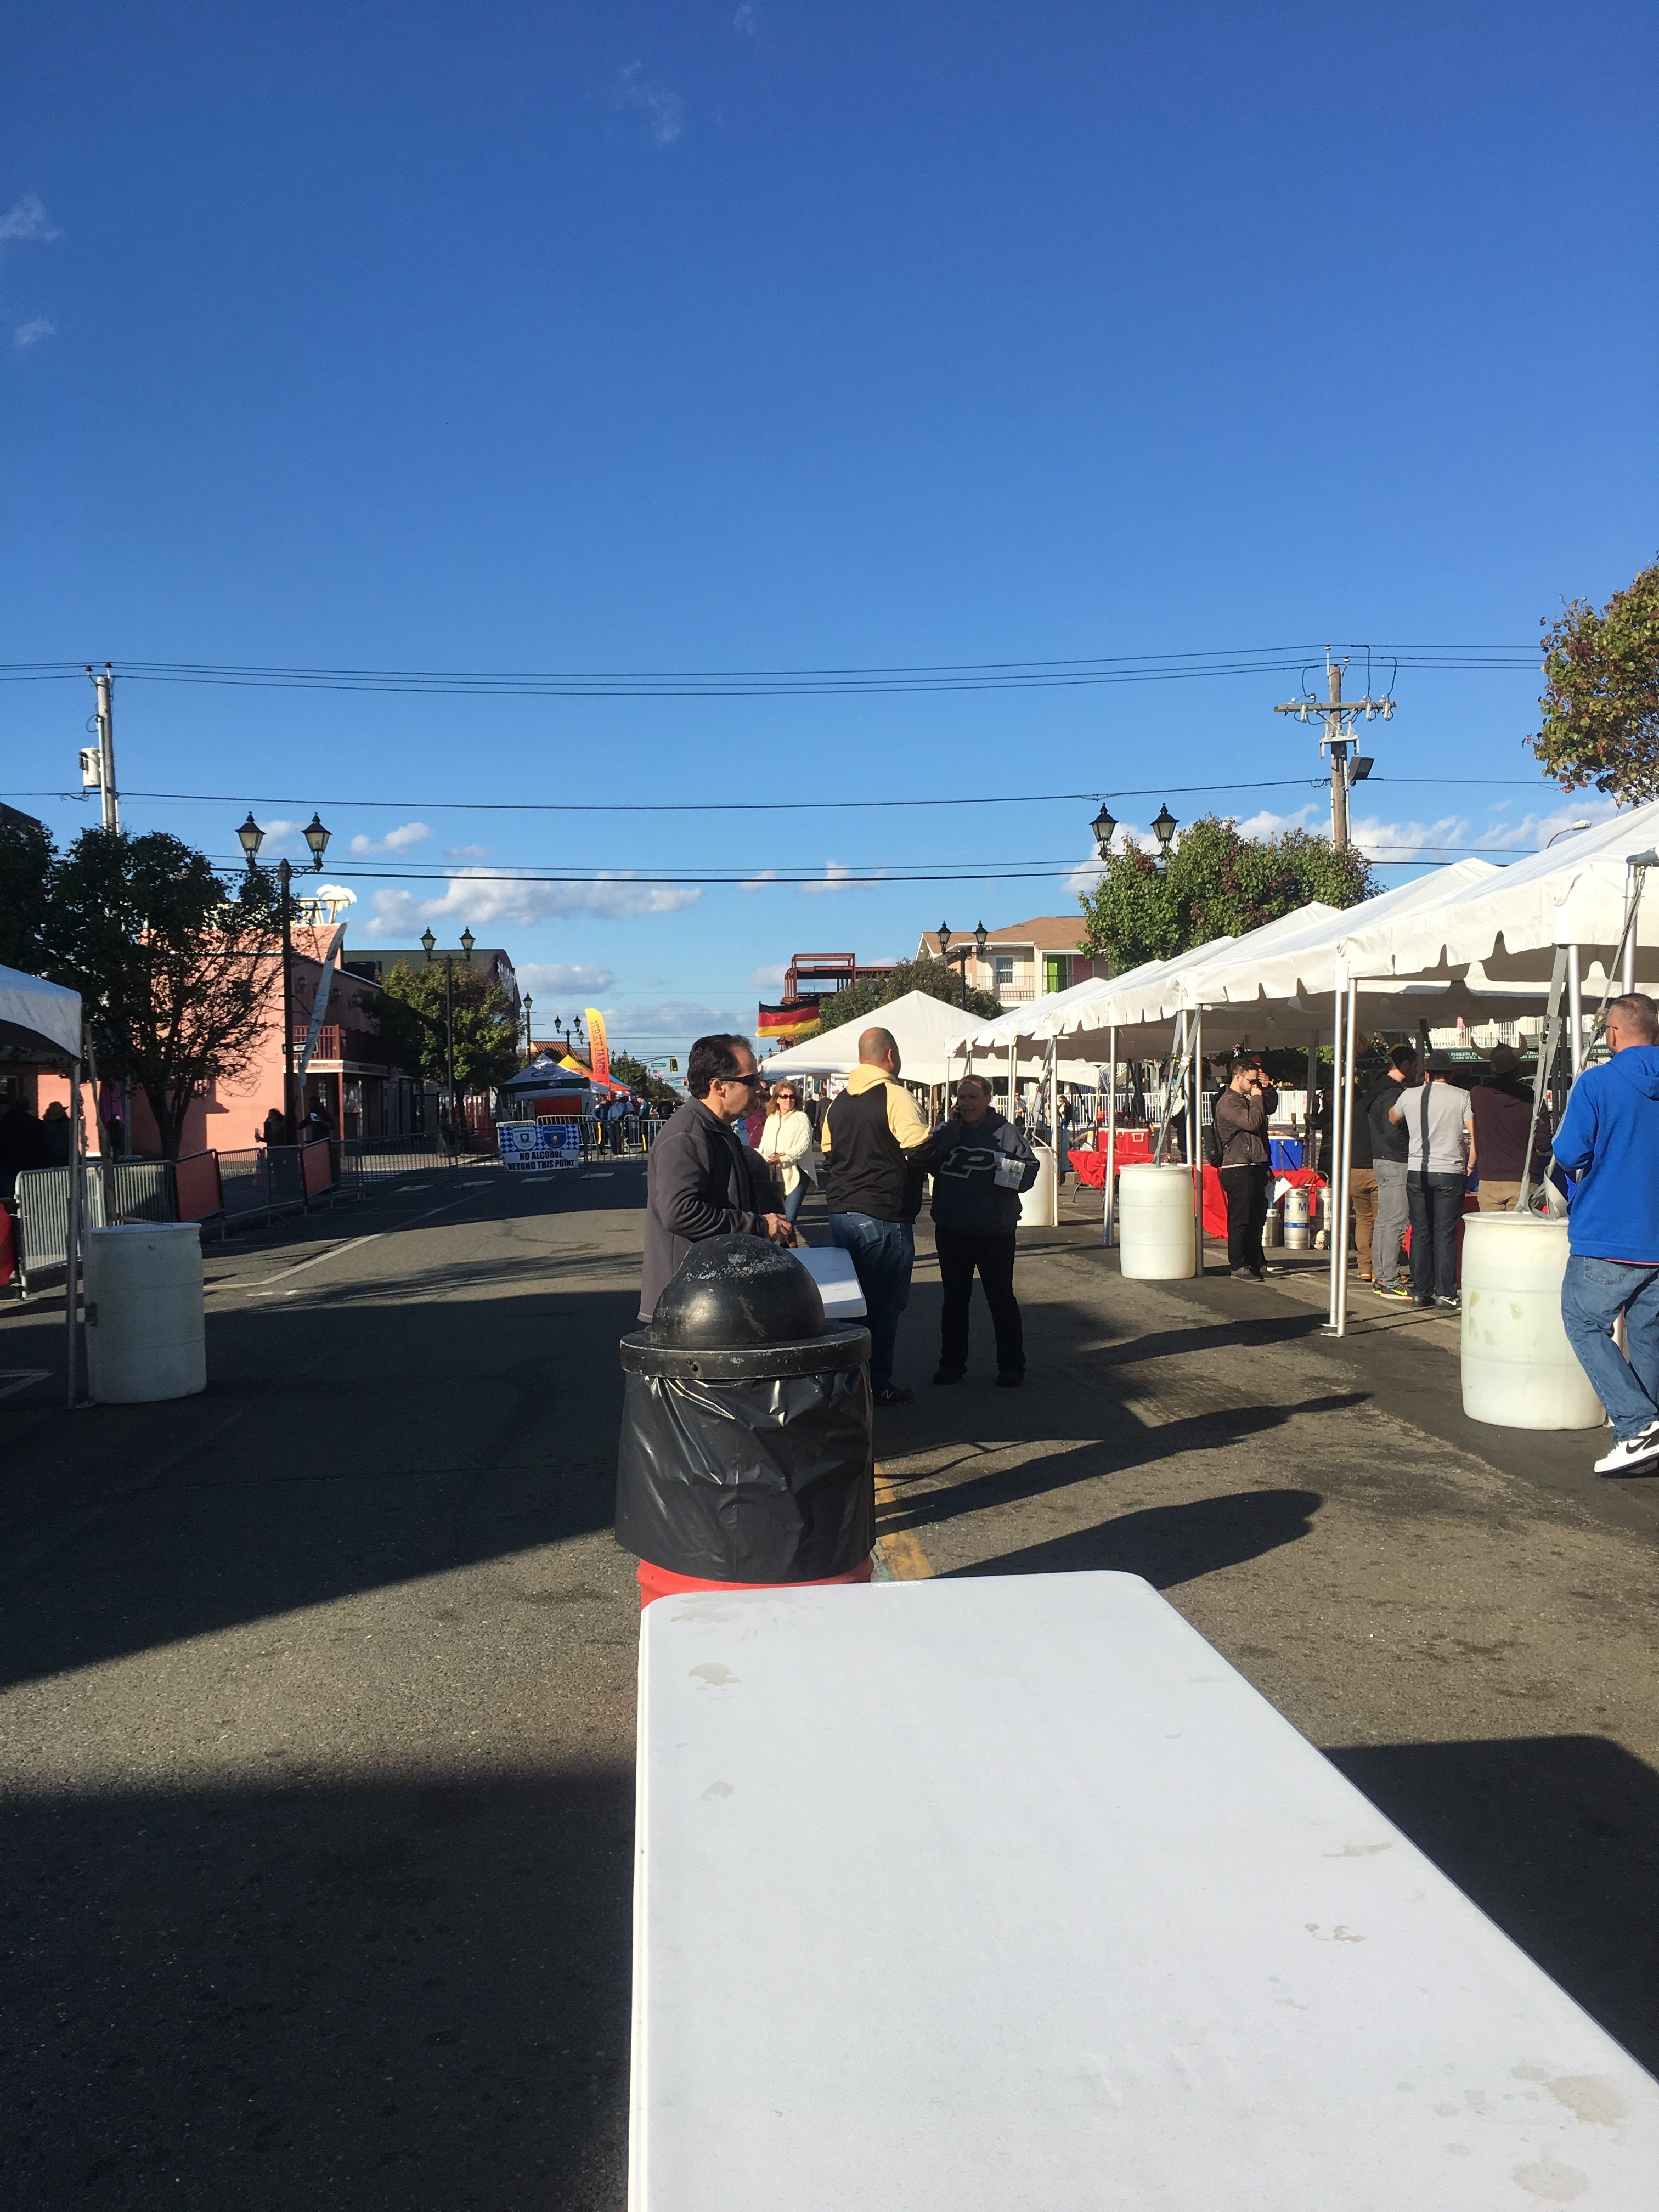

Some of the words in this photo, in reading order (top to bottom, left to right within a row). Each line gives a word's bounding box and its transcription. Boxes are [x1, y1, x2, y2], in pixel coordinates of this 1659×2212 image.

[519, 1152, 529, 1160] NO
[532, 1150, 562, 1159] ALCOHOL
[507, 1161, 535, 1170] BEYOND
[537, 1160, 554, 1169] THIS
[555, 1159, 575, 1168] POINT
[940, 1146, 998, 1178] P
